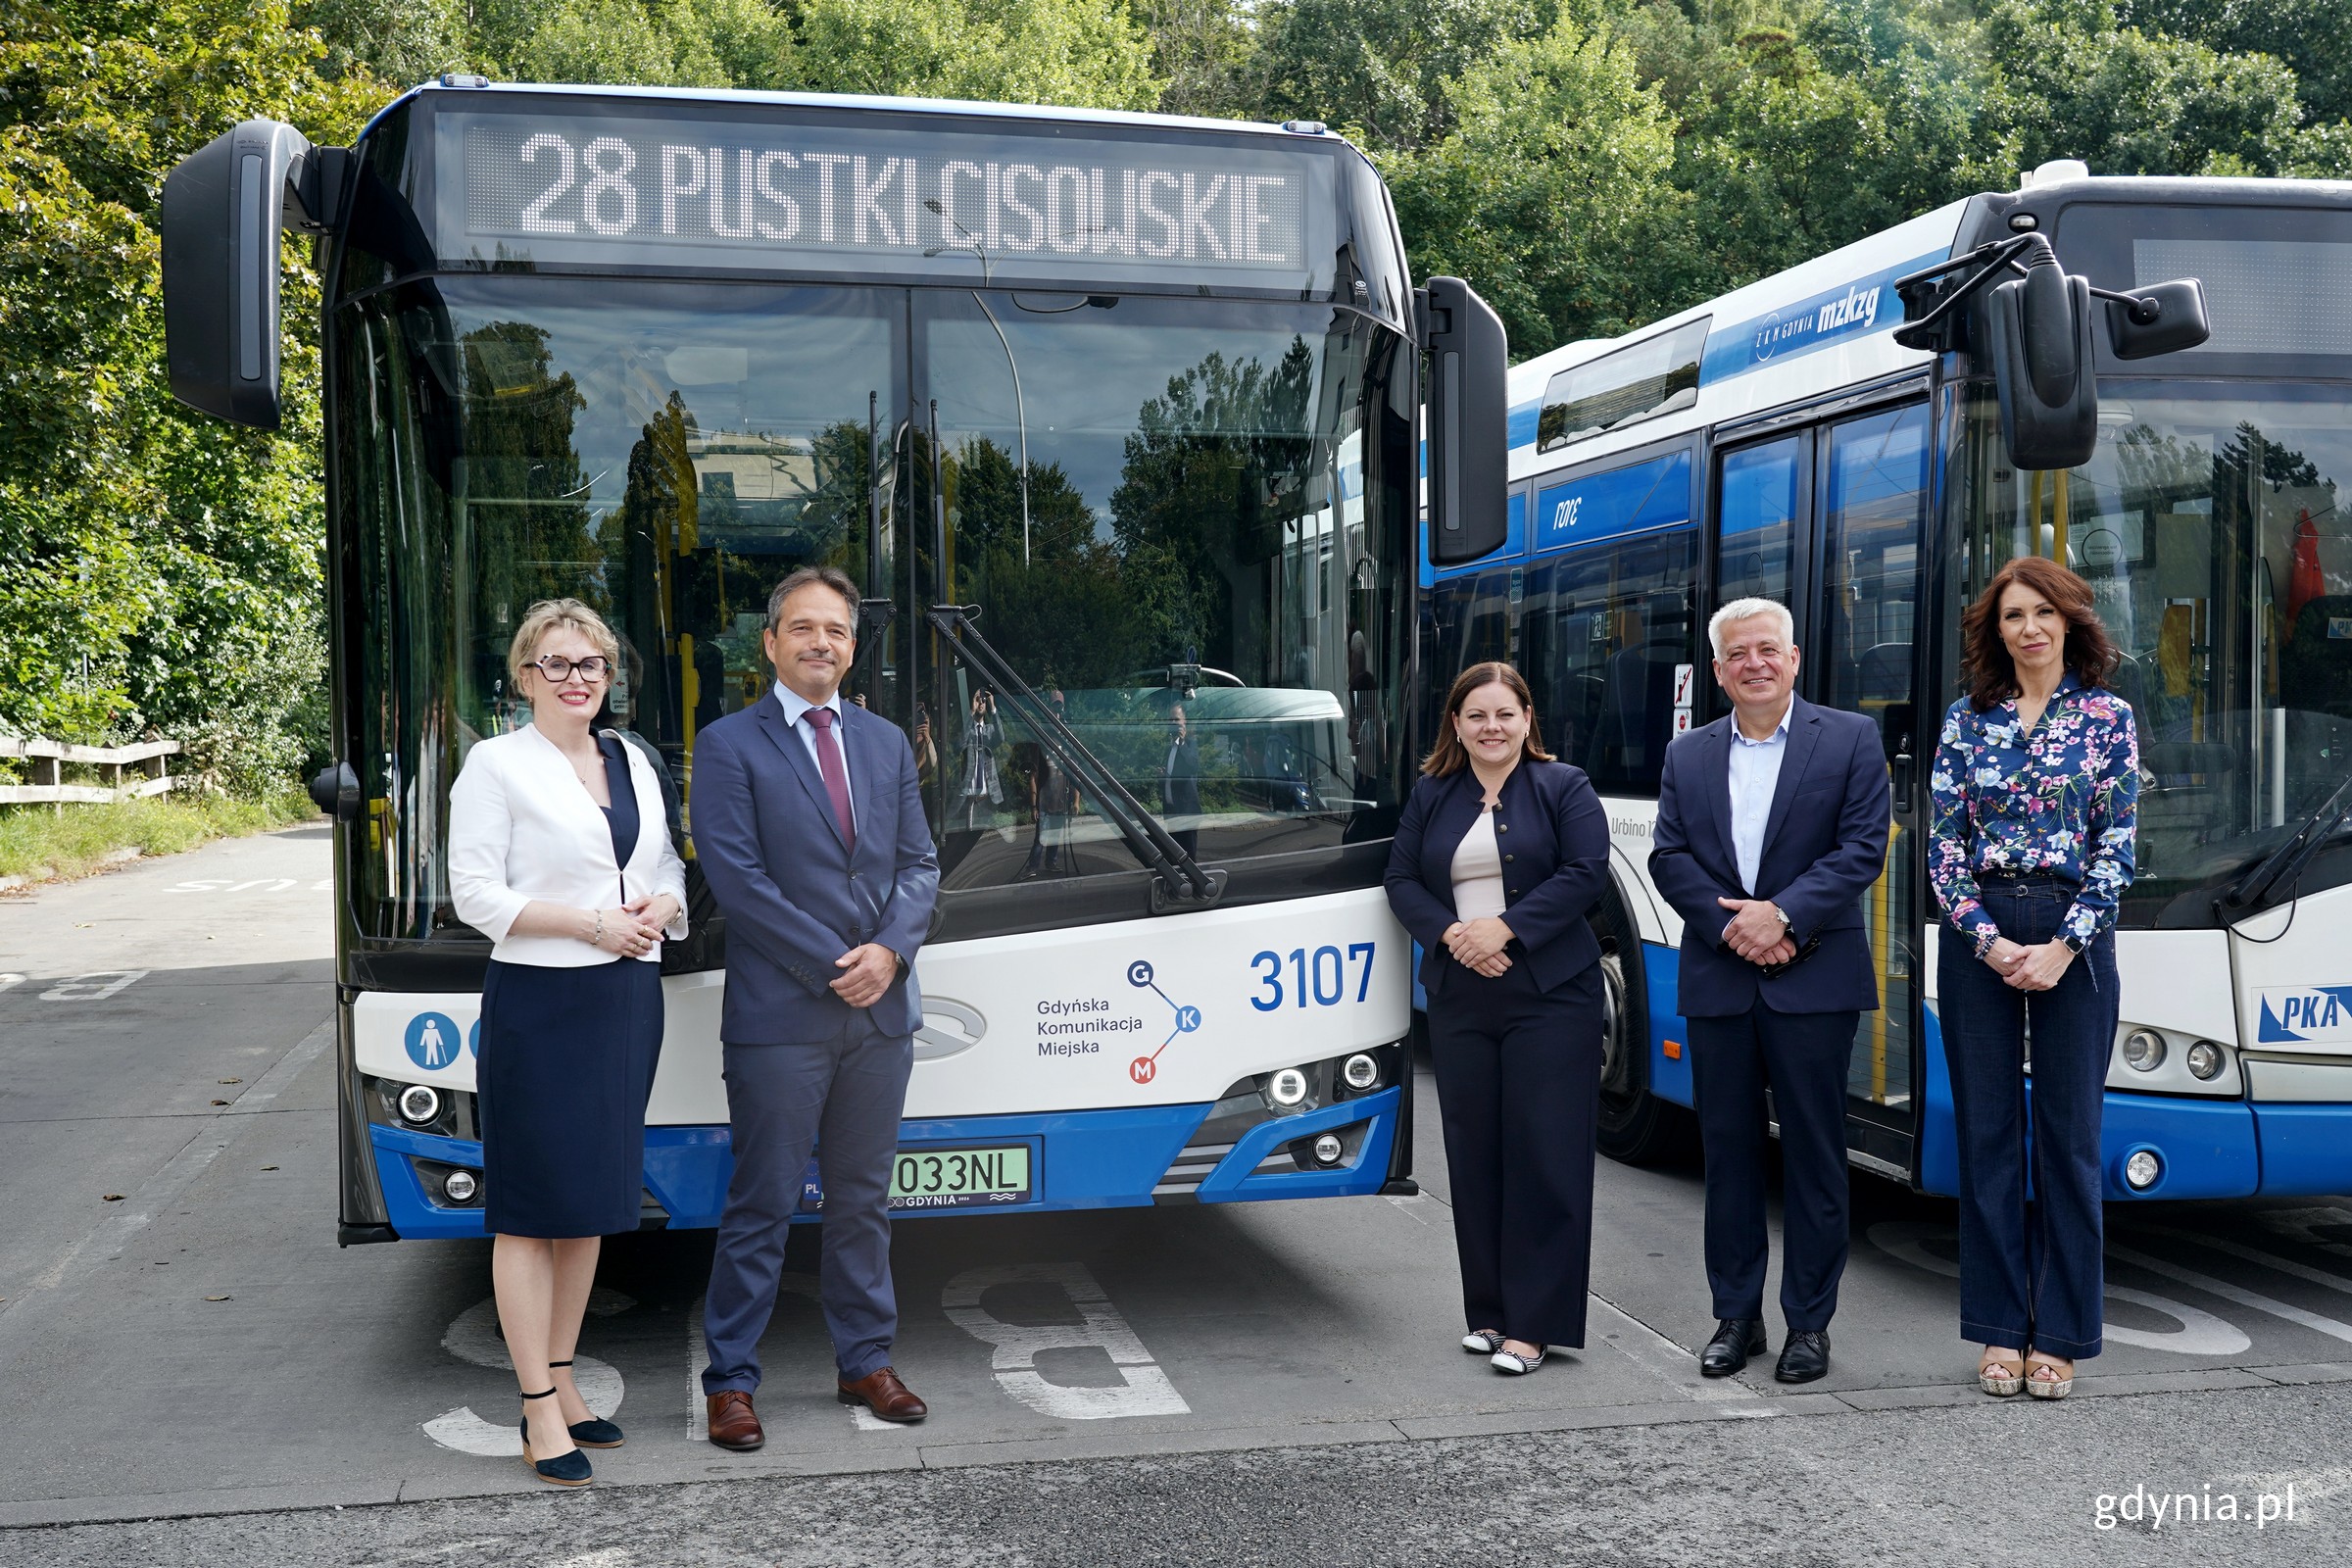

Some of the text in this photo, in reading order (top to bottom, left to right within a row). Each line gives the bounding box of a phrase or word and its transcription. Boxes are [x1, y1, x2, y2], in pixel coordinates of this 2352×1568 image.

[520, 133, 1286, 263] 28 PUSTKI CISOWSKIE
[1782, 315, 1814, 339] GDYNIA
[1817, 285, 1882, 334] mzkzg
[1611, 817, 1646, 837] Urbino
[1250, 942, 1376, 1011] 3107
[1037, 998, 1109, 1016] Gdyńska
[2282, 995, 2338, 1029] PKA
[1038, 1016, 1143, 1035] Komunikacja
[1038, 1040, 1100, 1057] Miejska
[898, 1152, 1018, 1193] 033NL
[806, 1183, 819, 1194] PL
[906, 1195, 956, 1206] GDYNIA
